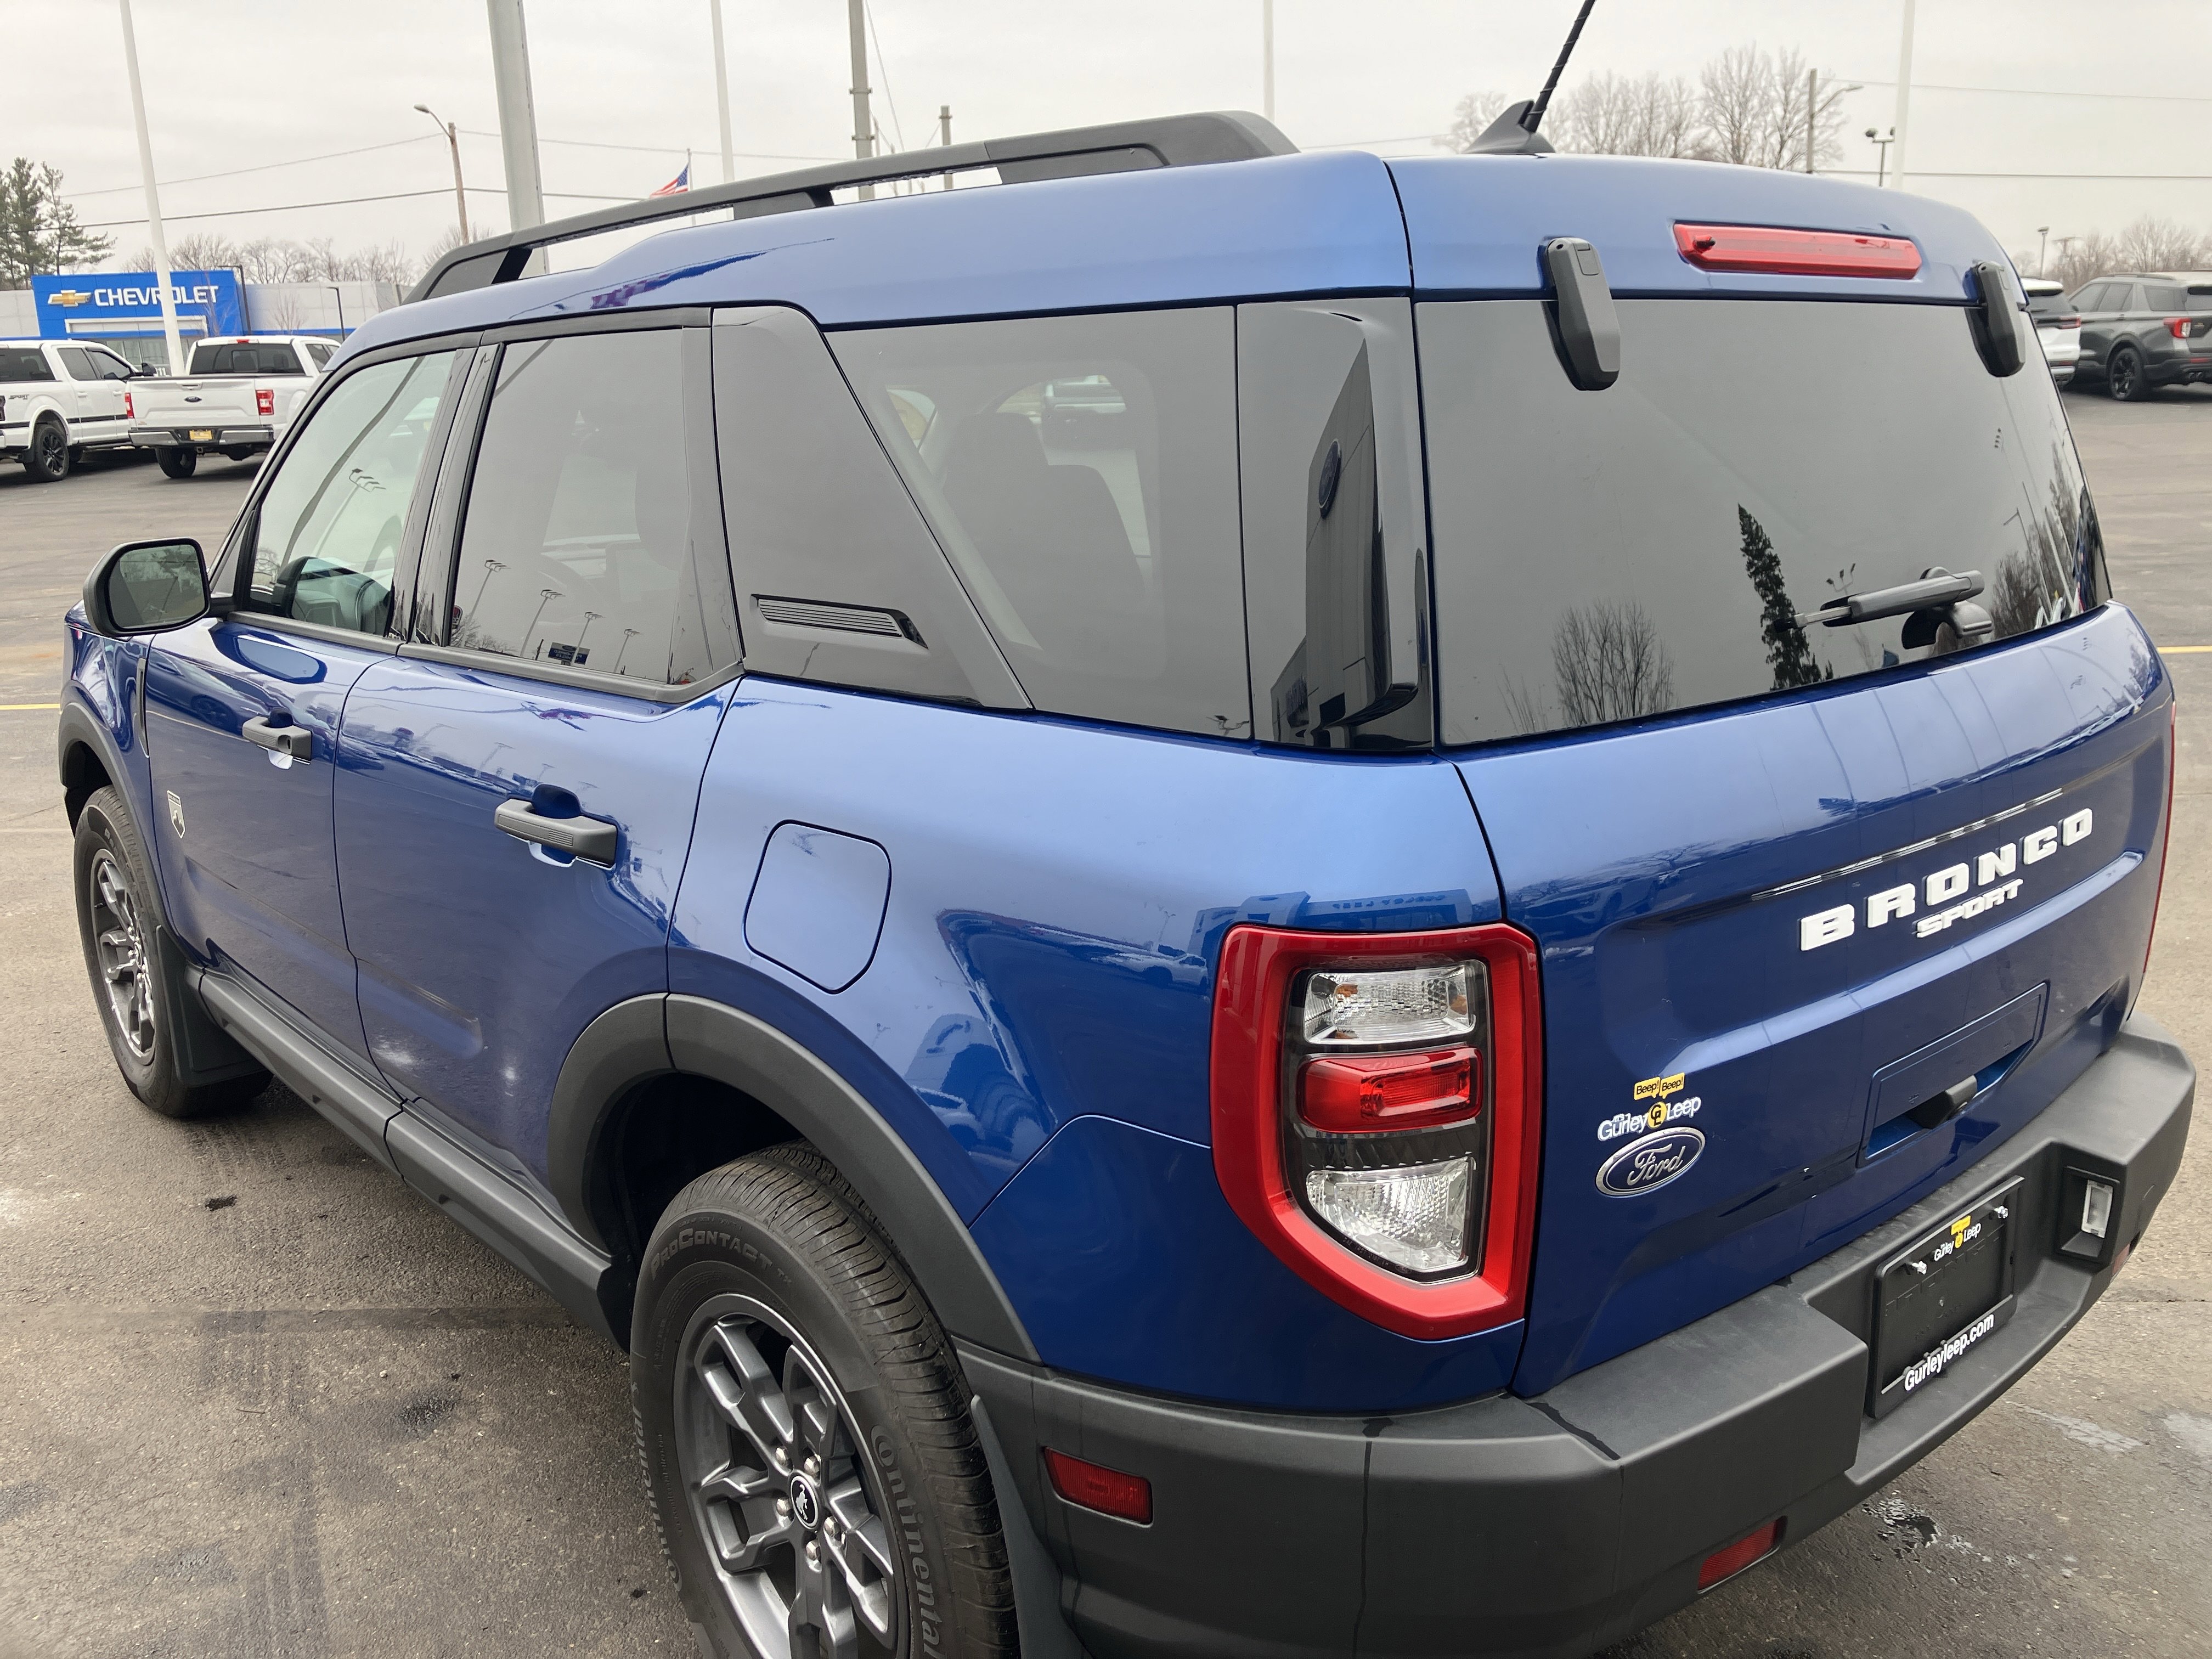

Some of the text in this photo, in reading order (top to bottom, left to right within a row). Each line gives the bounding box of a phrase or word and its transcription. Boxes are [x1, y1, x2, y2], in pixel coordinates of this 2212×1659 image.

[94, 285, 218, 306] CHEVROLET
[1800, 808, 2092, 951] BRONCO
[1916, 878, 2023, 938] SPORT
[1636, 1076, 1684, 1095] Beep! Beep!
[1598, 1113, 1649, 1141] Gurley
[1666, 1097, 1701, 1121] Leep
[1627, 1143, 1686, 1186] Ford
[1904, 1313, 1995, 1391] Gurleyleep.com
[870, 1425, 946, 1659] Continental
